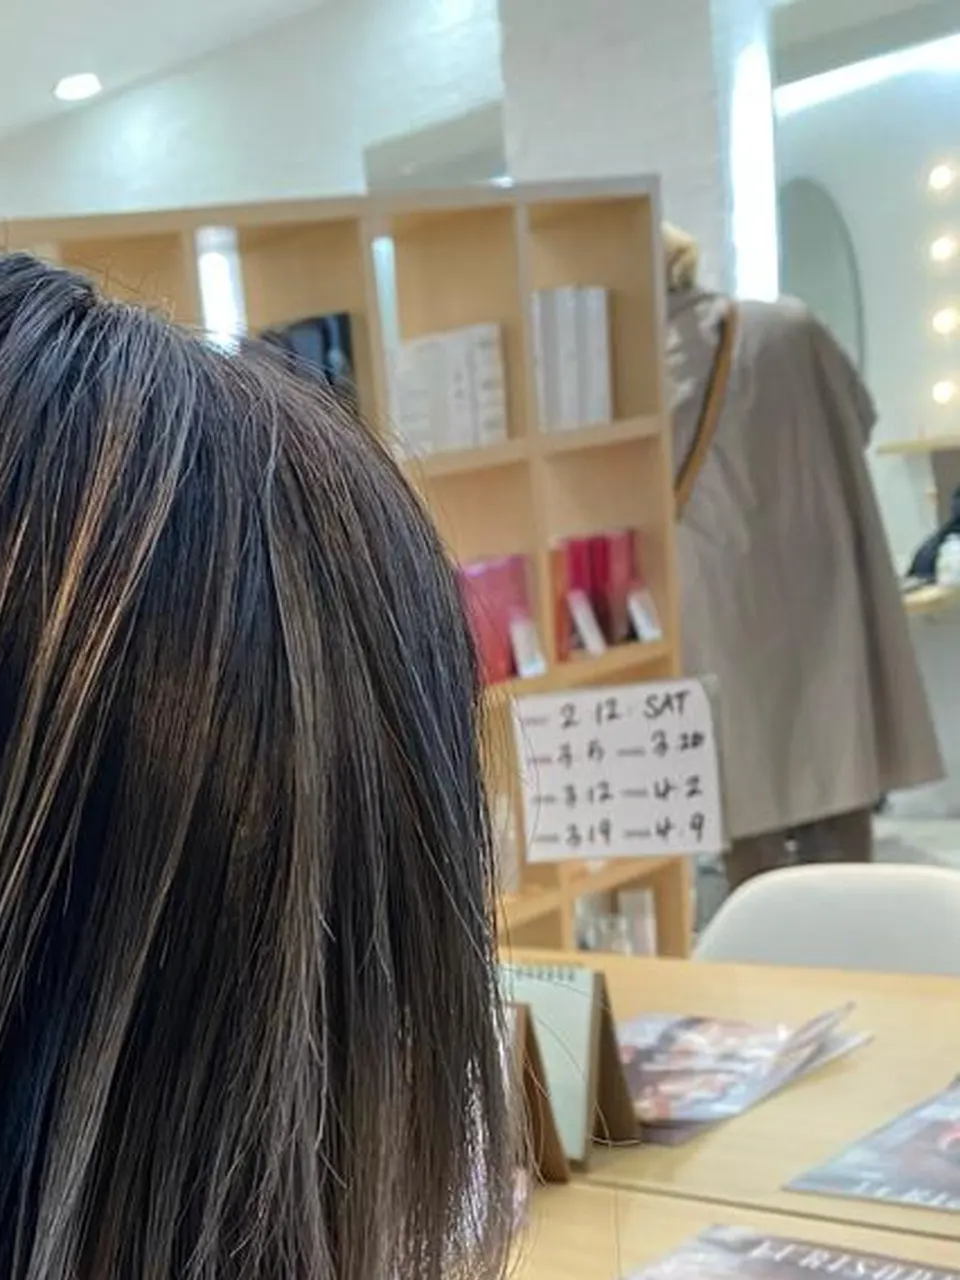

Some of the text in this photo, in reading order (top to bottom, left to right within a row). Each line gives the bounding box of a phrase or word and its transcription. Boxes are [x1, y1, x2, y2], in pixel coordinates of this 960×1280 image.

[561, 689, 692, 728] 2 12 SAT
[587, 781, 614, 804] 12
[689, 811, 705, 843] 9
